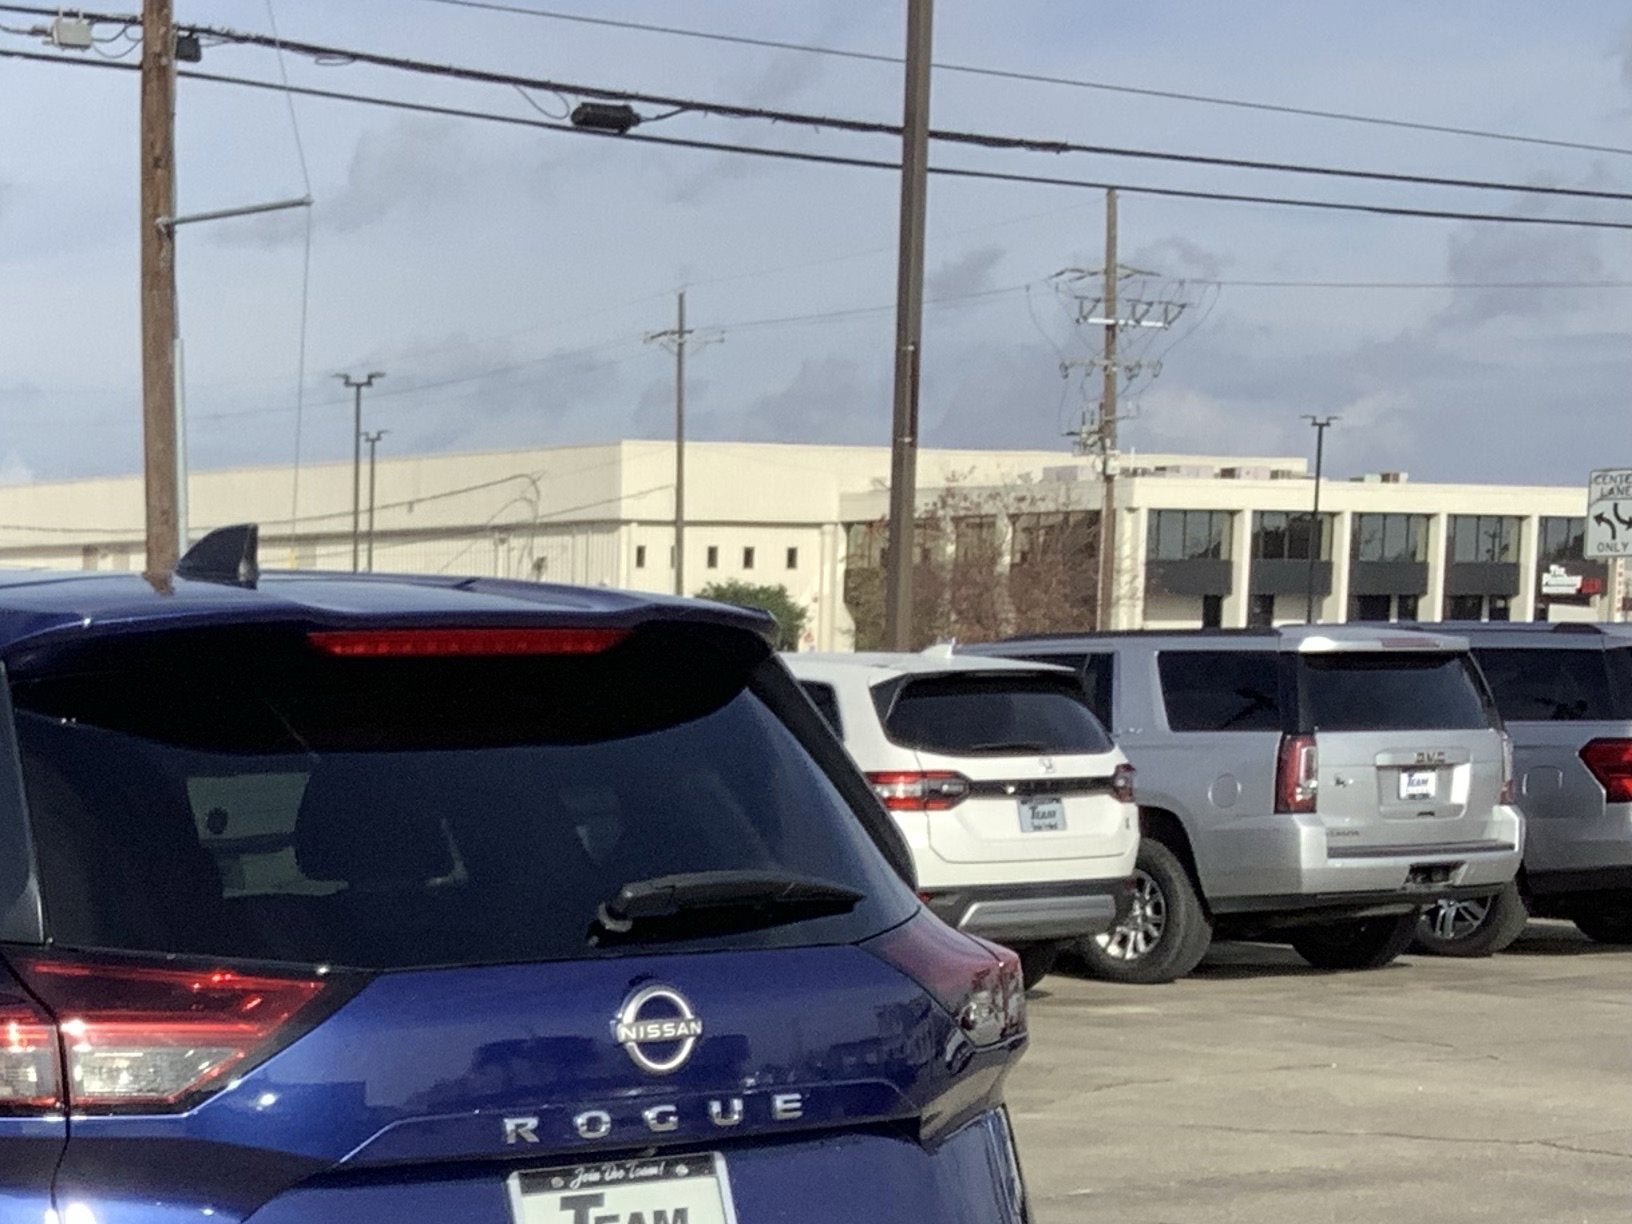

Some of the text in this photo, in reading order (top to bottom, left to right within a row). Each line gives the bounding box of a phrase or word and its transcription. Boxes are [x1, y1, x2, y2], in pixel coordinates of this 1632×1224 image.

[1599, 486, 1632, 497] LANE
[1596, 542, 1629, 553] ONLY
[618, 1019, 704, 1042] NISSAN
[502, 1092, 804, 1145] ROGUE
[569, 1159, 665, 1190] Join The Team!
